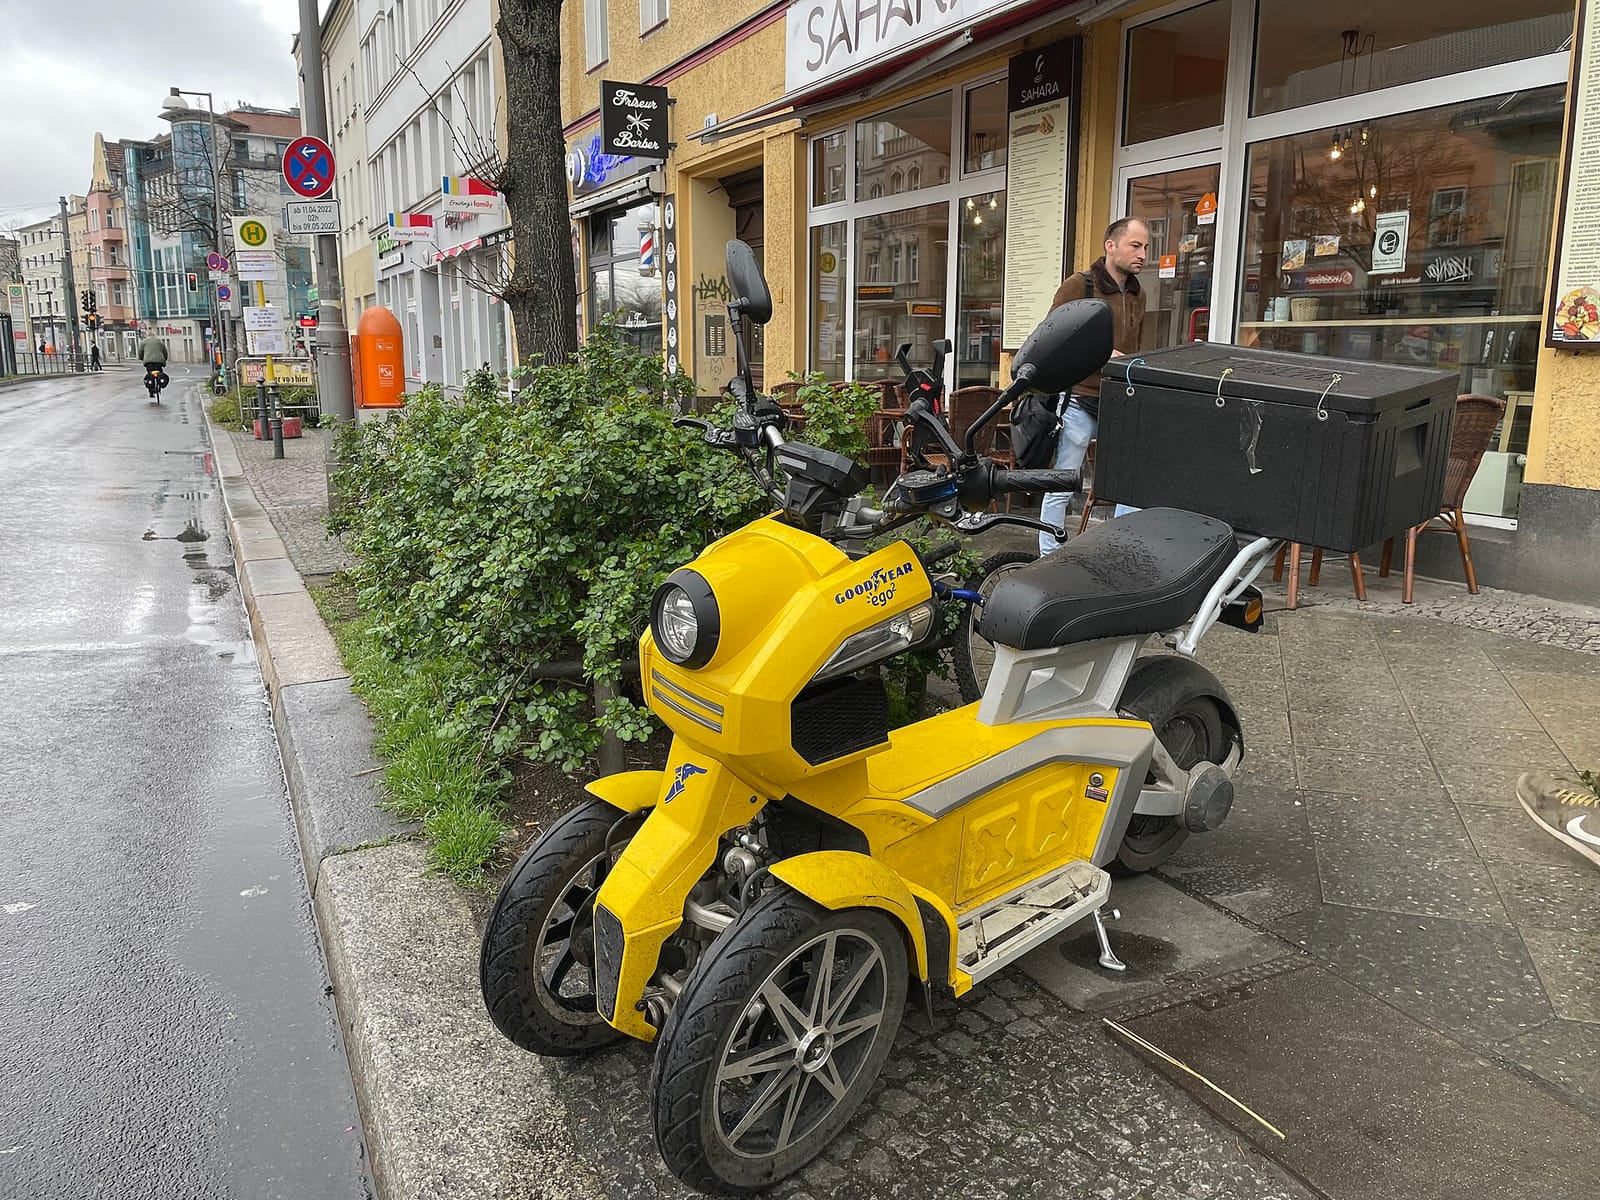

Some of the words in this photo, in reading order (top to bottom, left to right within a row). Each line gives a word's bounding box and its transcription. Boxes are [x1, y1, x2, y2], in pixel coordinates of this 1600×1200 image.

[613, 89, 658, 109] Friseur
[1021, 81, 1060, 103] SAHARA
[613, 131, 660, 150] Barber
[473, 200, 494, 209] family
[303, 222, 335, 230] 09.05.2022
[295, 375, 308, 383] hier
[835, 562, 913, 604] GOODYEAR
